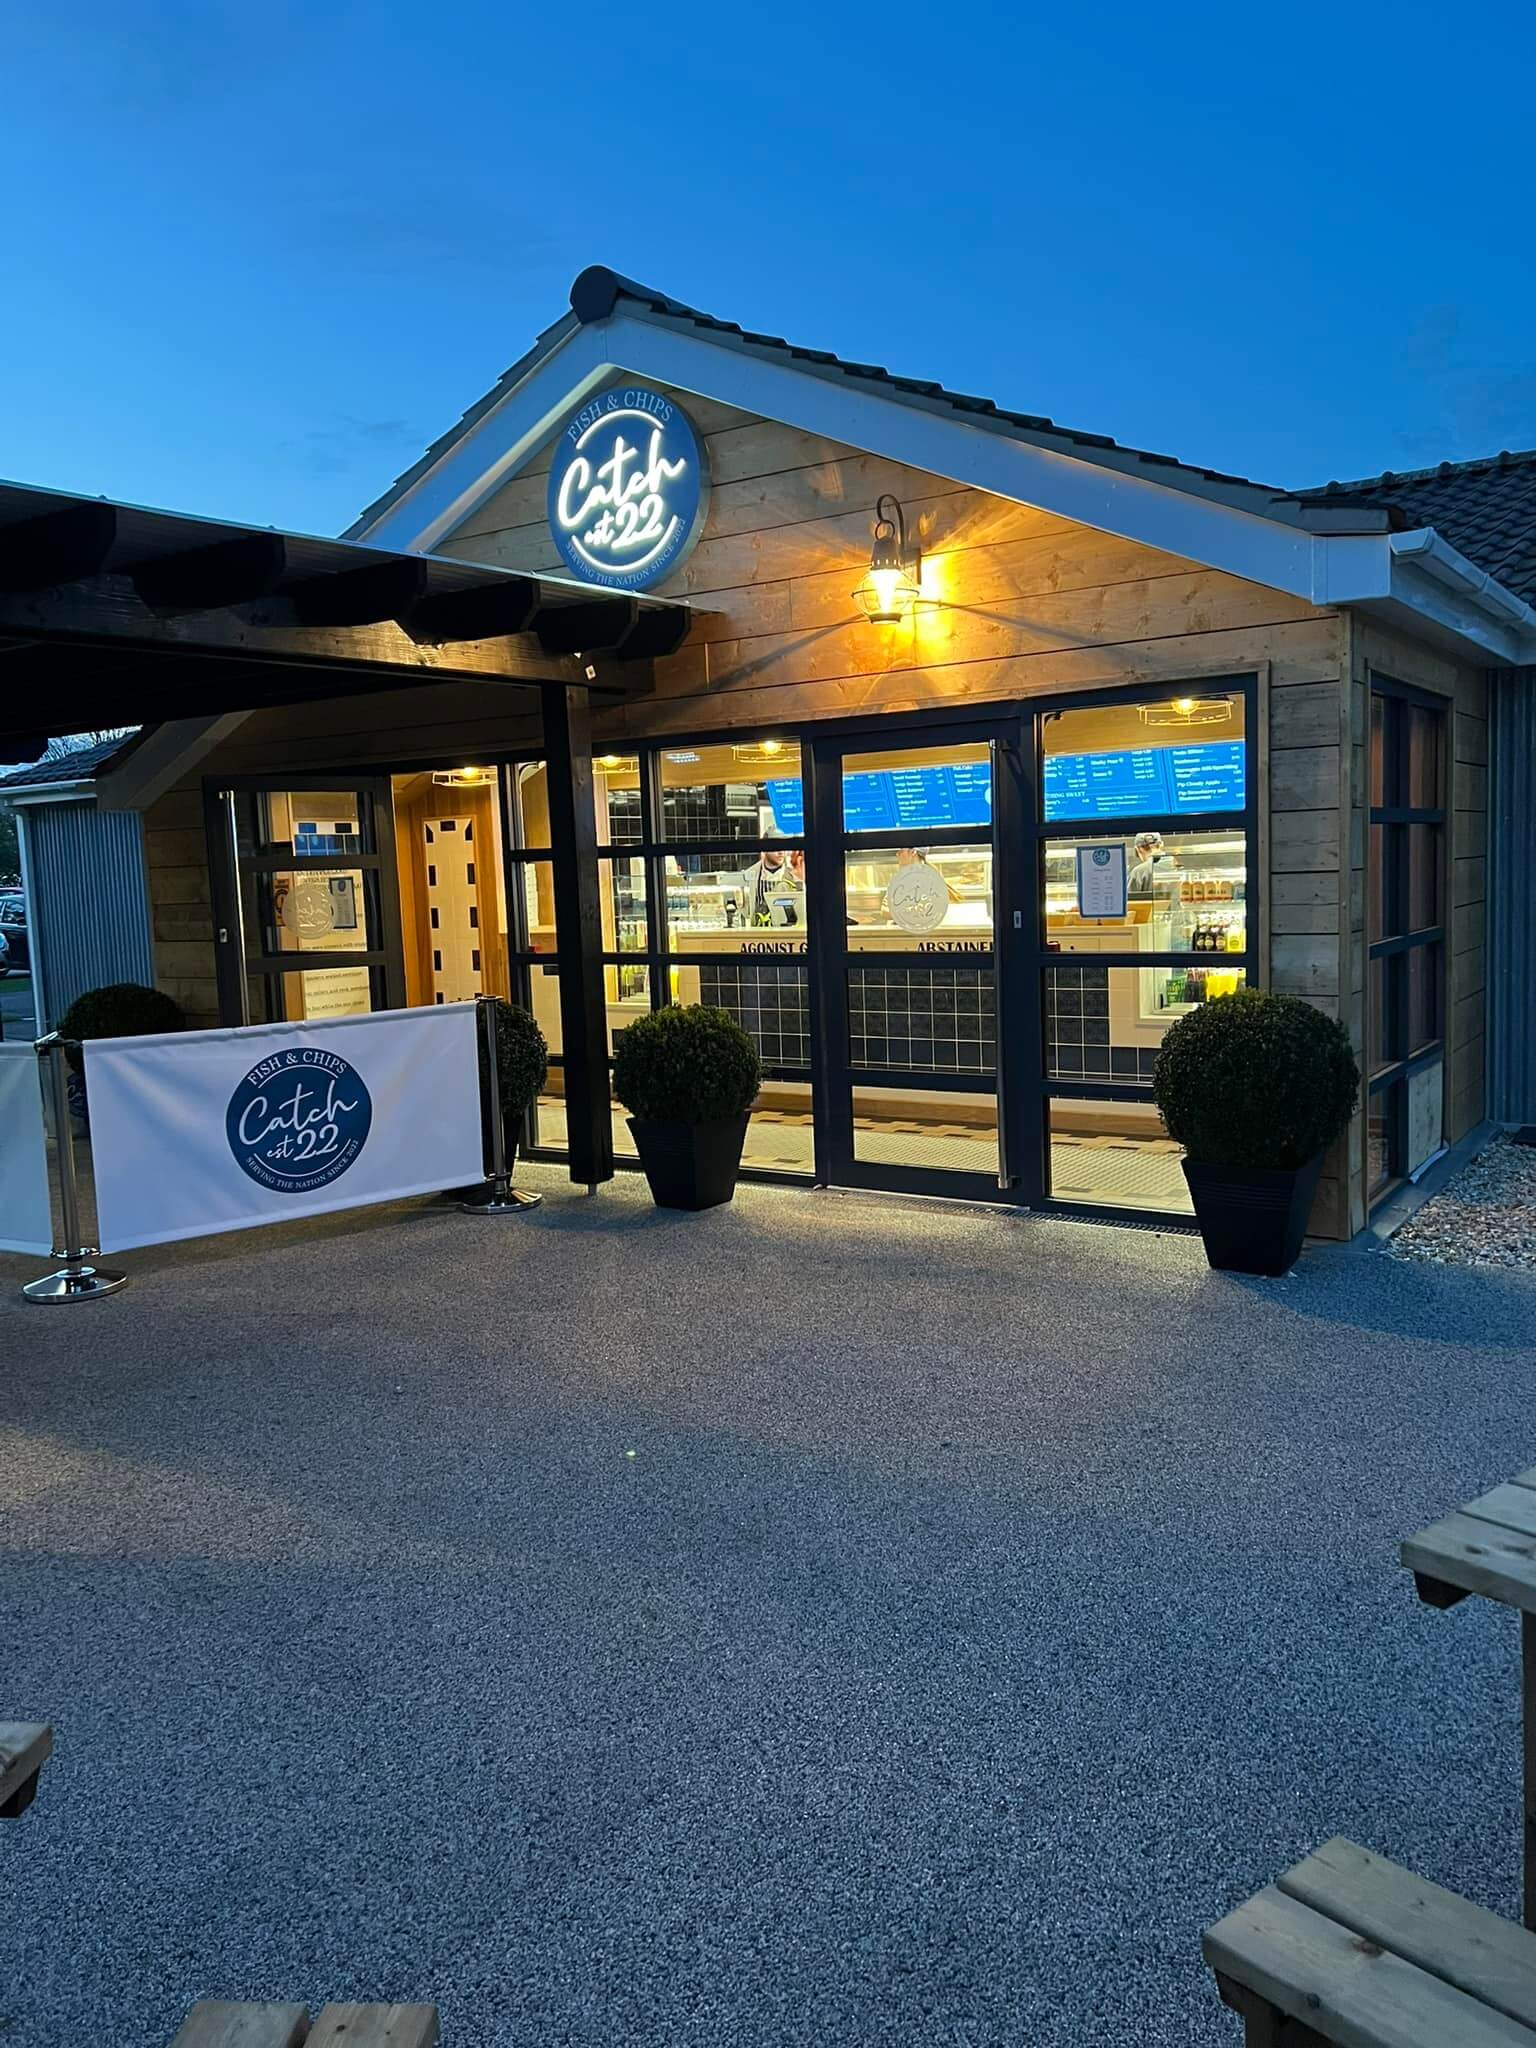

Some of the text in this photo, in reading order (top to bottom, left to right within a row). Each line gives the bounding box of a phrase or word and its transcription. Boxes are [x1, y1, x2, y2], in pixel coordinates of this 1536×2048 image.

[567, 391, 673, 444] FISH & CHIPS
[558, 428, 686, 528] Catch
[611, 494, 665, 550] 22
[566, 542, 595, 579] SERVING
[596, 571, 614, 585] THE
[614, 571, 650, 586] NATION
[650, 544, 675, 574] SINCE
[247, 1051, 347, 1086] FISH & CHIPS
[239, 1079, 359, 1145] Catch
[266, 1124, 339, 1162] est 22
[246, 1157, 275, 1184] SERVING
[276, 1179, 293, 1189] THE
[295, 1175, 326, 1189] NATION
[327, 1158, 349, 1176] SINCE
